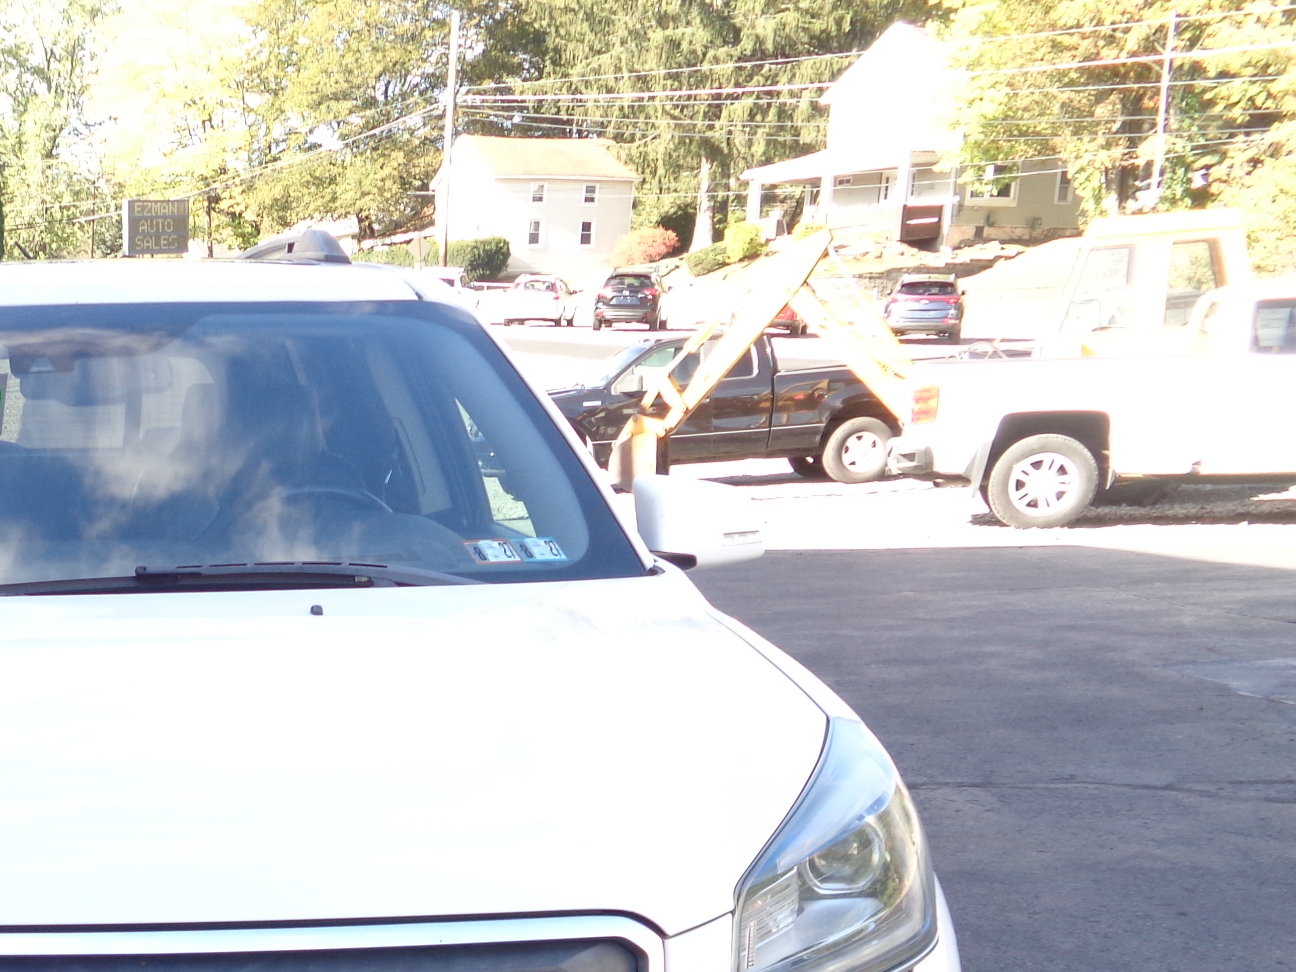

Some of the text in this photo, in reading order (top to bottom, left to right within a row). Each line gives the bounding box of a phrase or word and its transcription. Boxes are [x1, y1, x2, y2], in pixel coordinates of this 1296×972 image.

[134, 202, 178, 216] EZMAN
[139, 219, 174, 233] AUTO
[135, 235, 178, 250] SALES
